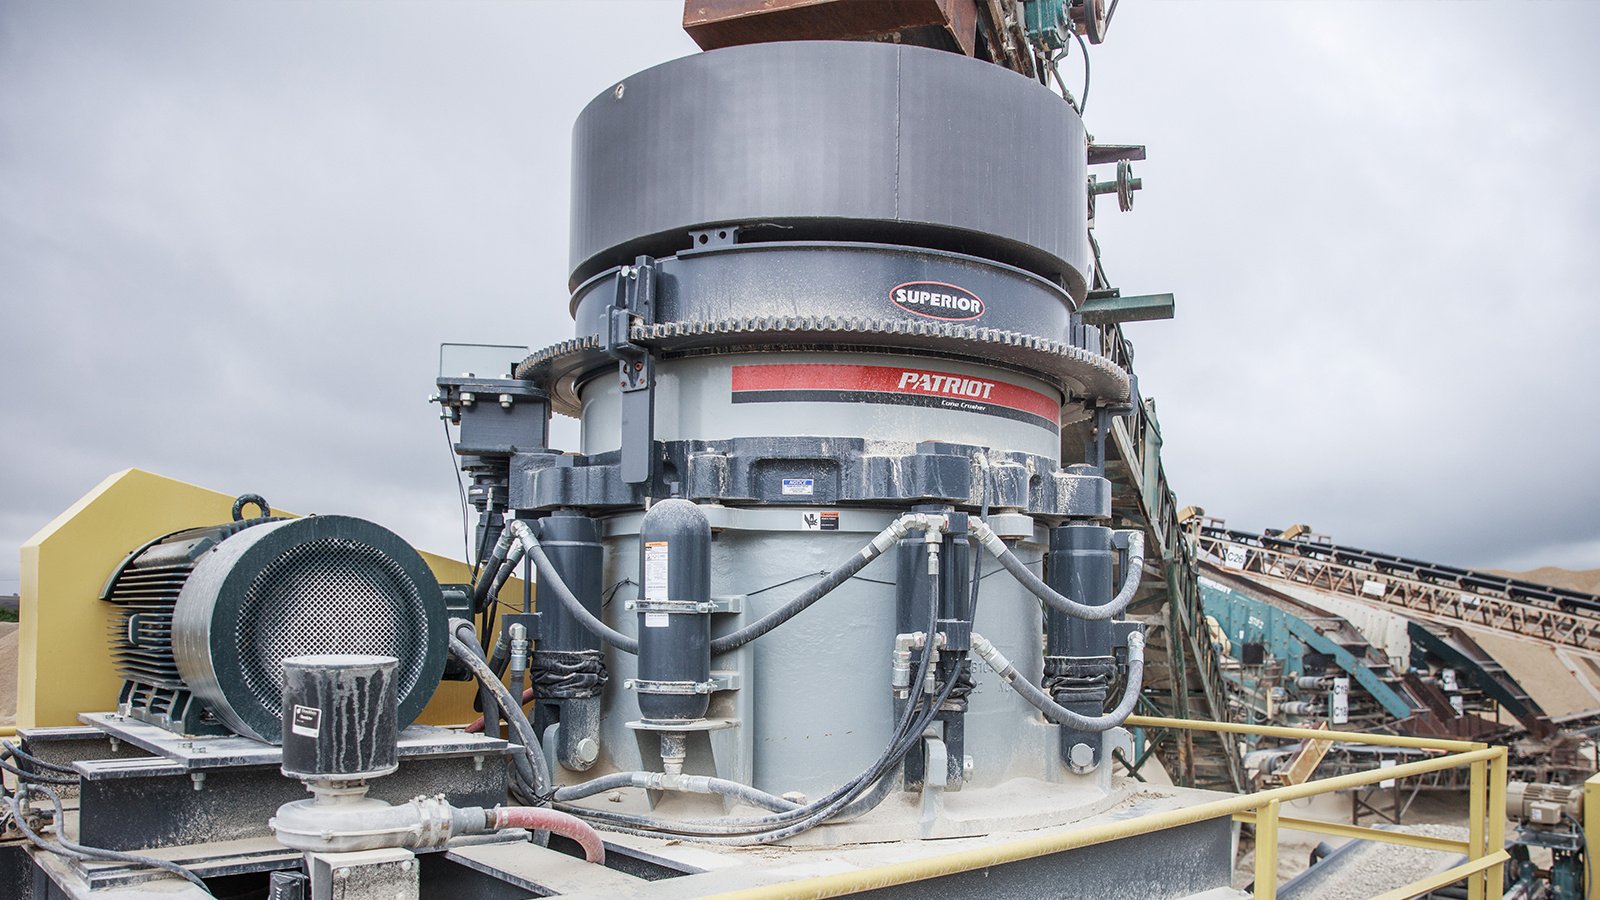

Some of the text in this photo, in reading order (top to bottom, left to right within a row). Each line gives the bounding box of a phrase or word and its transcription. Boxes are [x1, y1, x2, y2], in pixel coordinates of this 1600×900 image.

[896, 288, 981, 313] SUPERIOR
[898, 372, 995, 399] PATRIOT
[941, 400, 986, 411] Cone Crusher
[1227, 552, 1244, 564] C26
